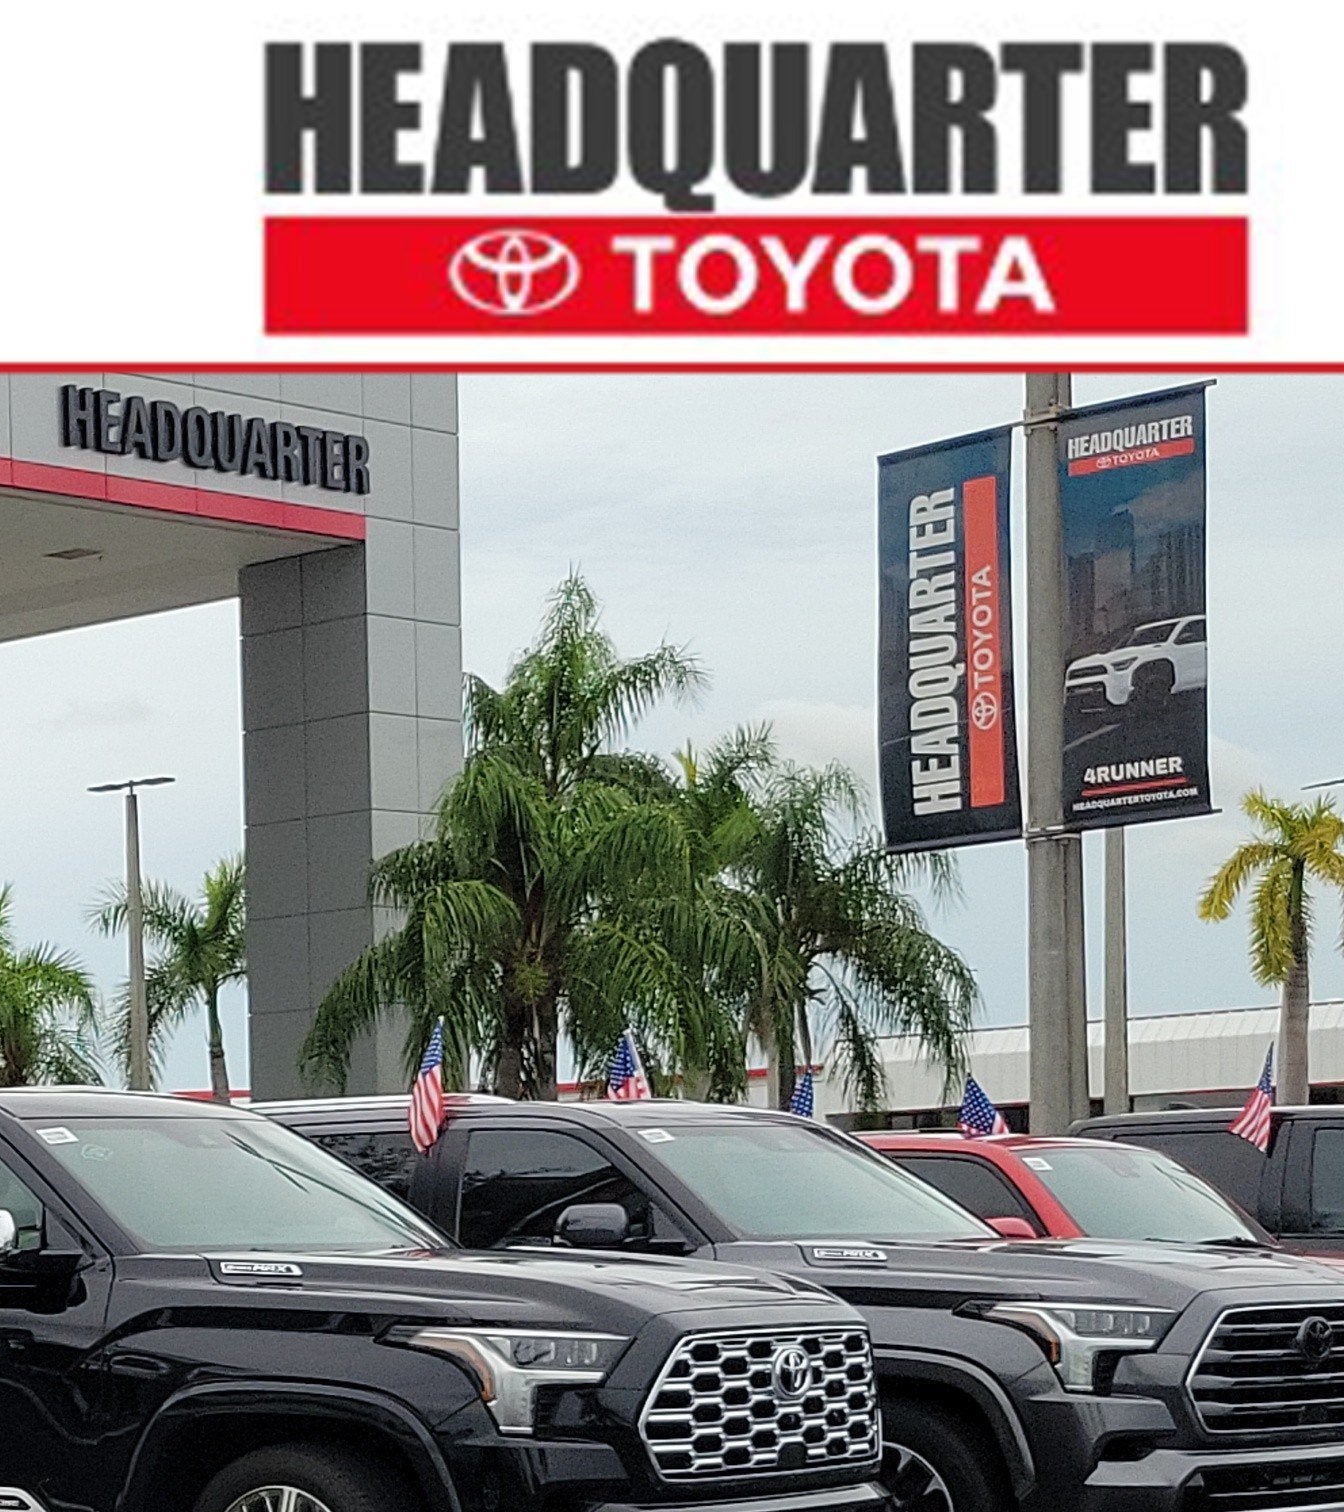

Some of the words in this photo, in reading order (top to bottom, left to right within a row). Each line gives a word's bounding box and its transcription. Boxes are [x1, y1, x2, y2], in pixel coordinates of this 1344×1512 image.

[60, 384, 371, 495] HEADQUARTER
[1067, 415, 1194, 459] HEADQUARTER
[1112, 447, 1160, 466] TOYOTA
[909, 487, 966, 816] HEADQUARTER
[972, 565, 995, 689] TOYOTA
[1083, 756, 1184, 784] 4RUNNER
